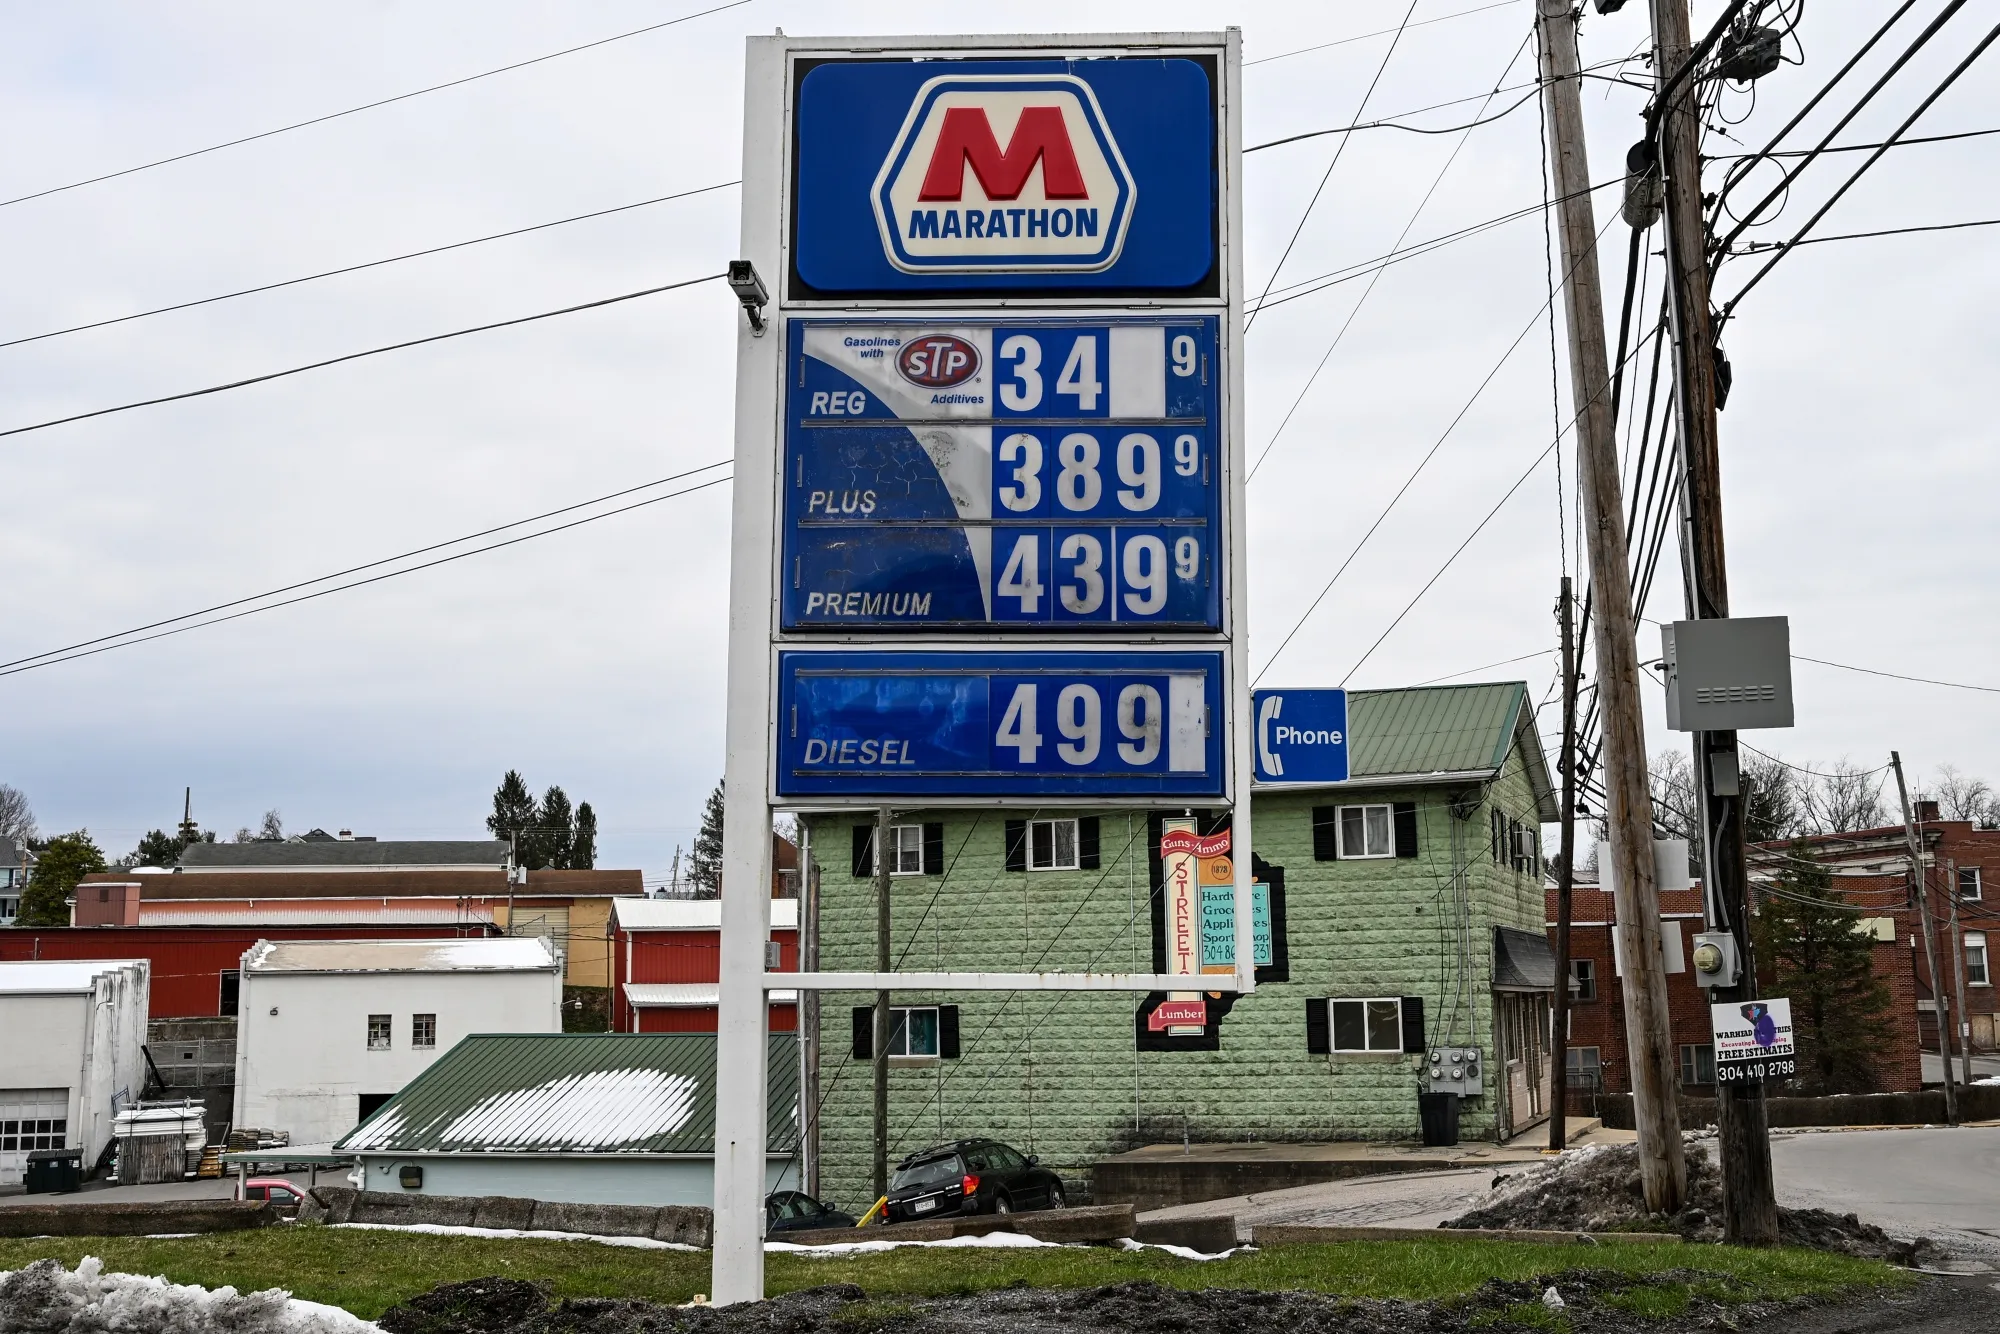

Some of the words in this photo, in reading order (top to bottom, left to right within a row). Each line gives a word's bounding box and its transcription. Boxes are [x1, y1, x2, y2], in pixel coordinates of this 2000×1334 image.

[916, 105, 1090, 202] M
[908, 207, 1098, 239] MARATHON
[843, 336, 901, 347] Gasolines
[860, 348, 884, 358] with
[907, 341, 968, 379] STP
[810, 391, 867, 415] REG
[930, 394, 984, 404] Additives
[808, 489, 877, 514] PLUS
[805, 591, 933, 616] PREMIUM
[995, 683, 1162, 766] 499
[1276, 726, 1342, 745] Phone
[803, 738, 916, 765] DIESEL
[1162, 839, 1190, 849] Guns
[1193, 839, 1229, 854] Ammo
[1201, 891, 1261, 901] Harde
[1175, 862, 1194, 975] STREET'
[1203, 919, 1268, 931] Applies
[1158, 1008, 1204, 1019] Lumber
[1716, 1029, 1753, 1039] WARHEAD
[1717, 1048, 1744, 1060] FREE
[1745, 1043, 1793, 1058] ESTIMATES
[1721, 1040, 1751, 1048] Excavating
[1718, 1066, 1744, 1081] 304
[1747, 1063, 1765, 1078] 410
[1768, 1060, 1795, 1076] 2798
